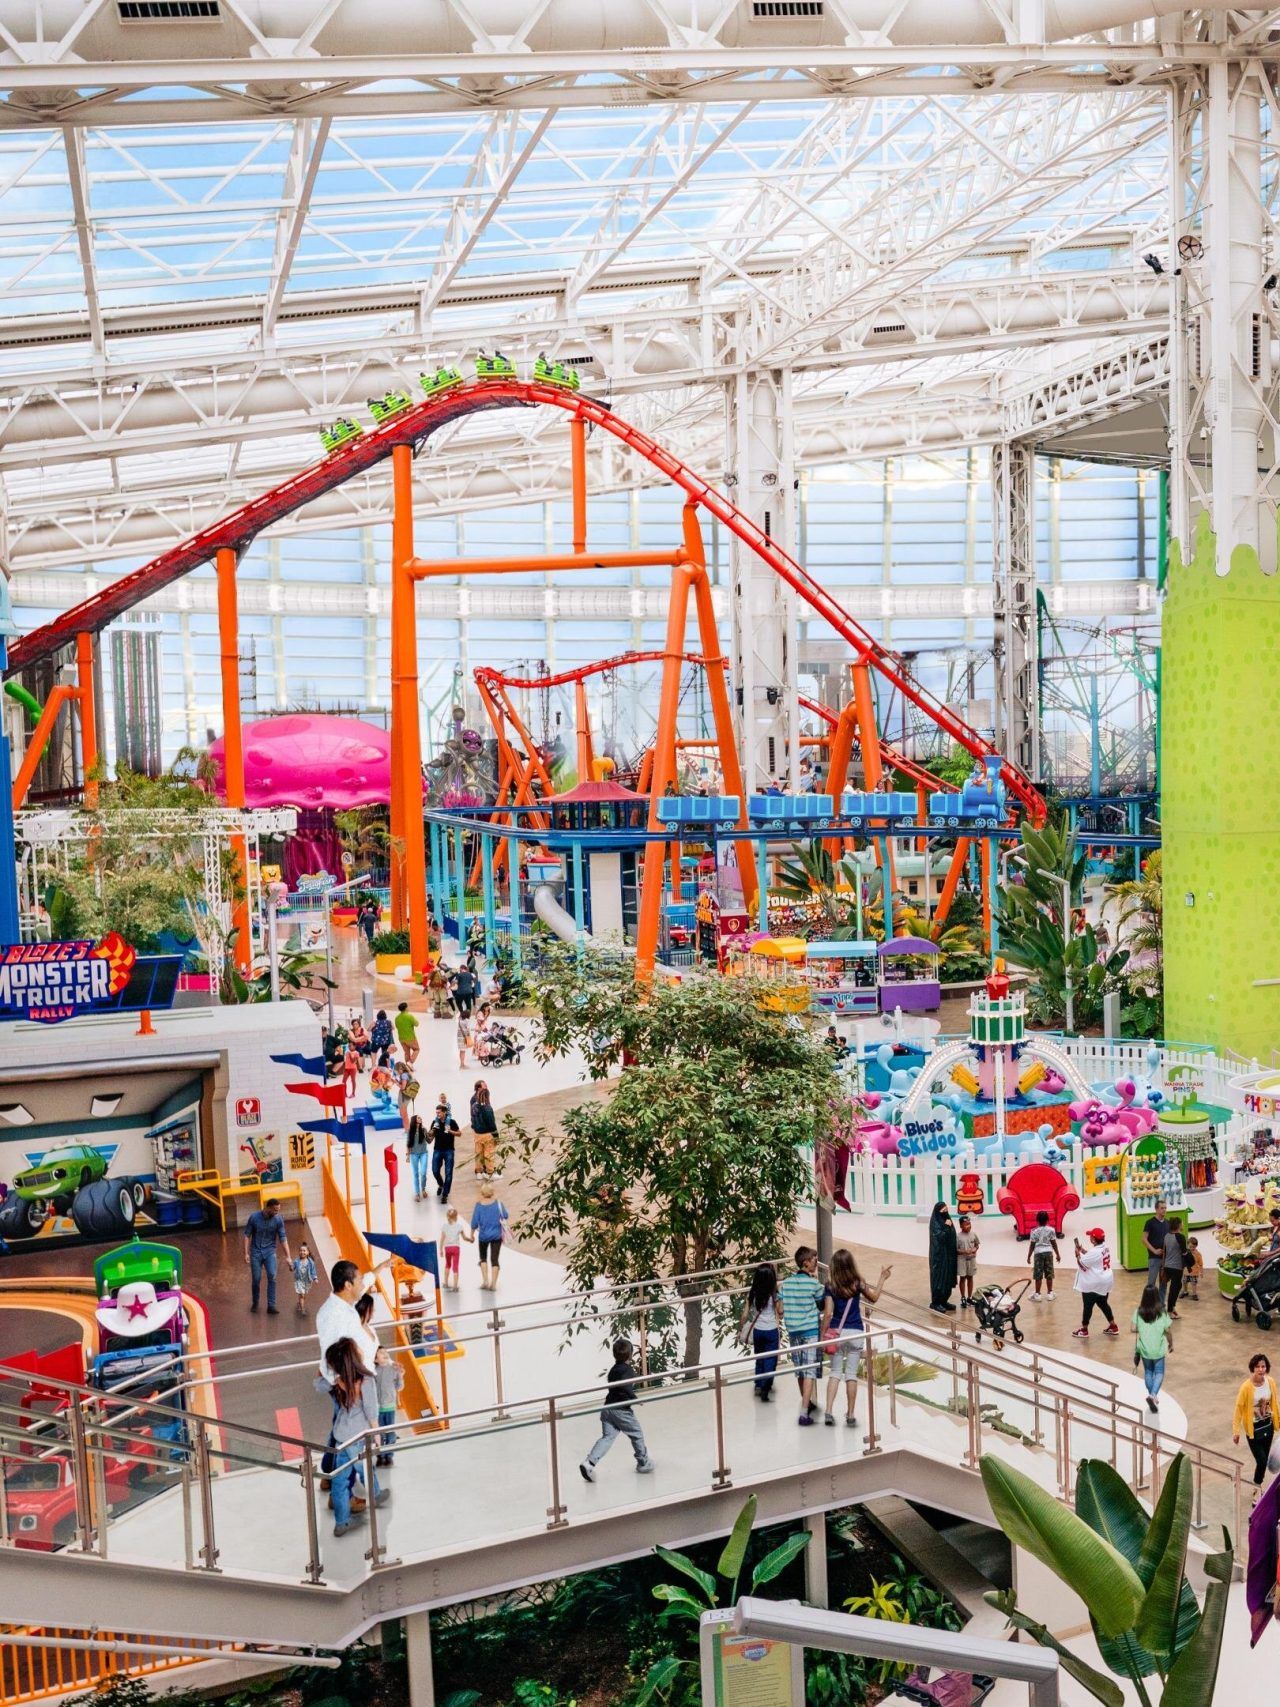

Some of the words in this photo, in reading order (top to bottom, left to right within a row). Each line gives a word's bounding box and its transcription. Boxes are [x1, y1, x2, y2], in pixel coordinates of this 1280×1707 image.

[766, 892, 821, 908] OULER
[0, 959, 109, 1005] MONSTER
[12, 984, 92, 1008] TRUCK
[29, 1006, 74, 1020] RALLY
[905, 1119, 944, 1137] Blue's
